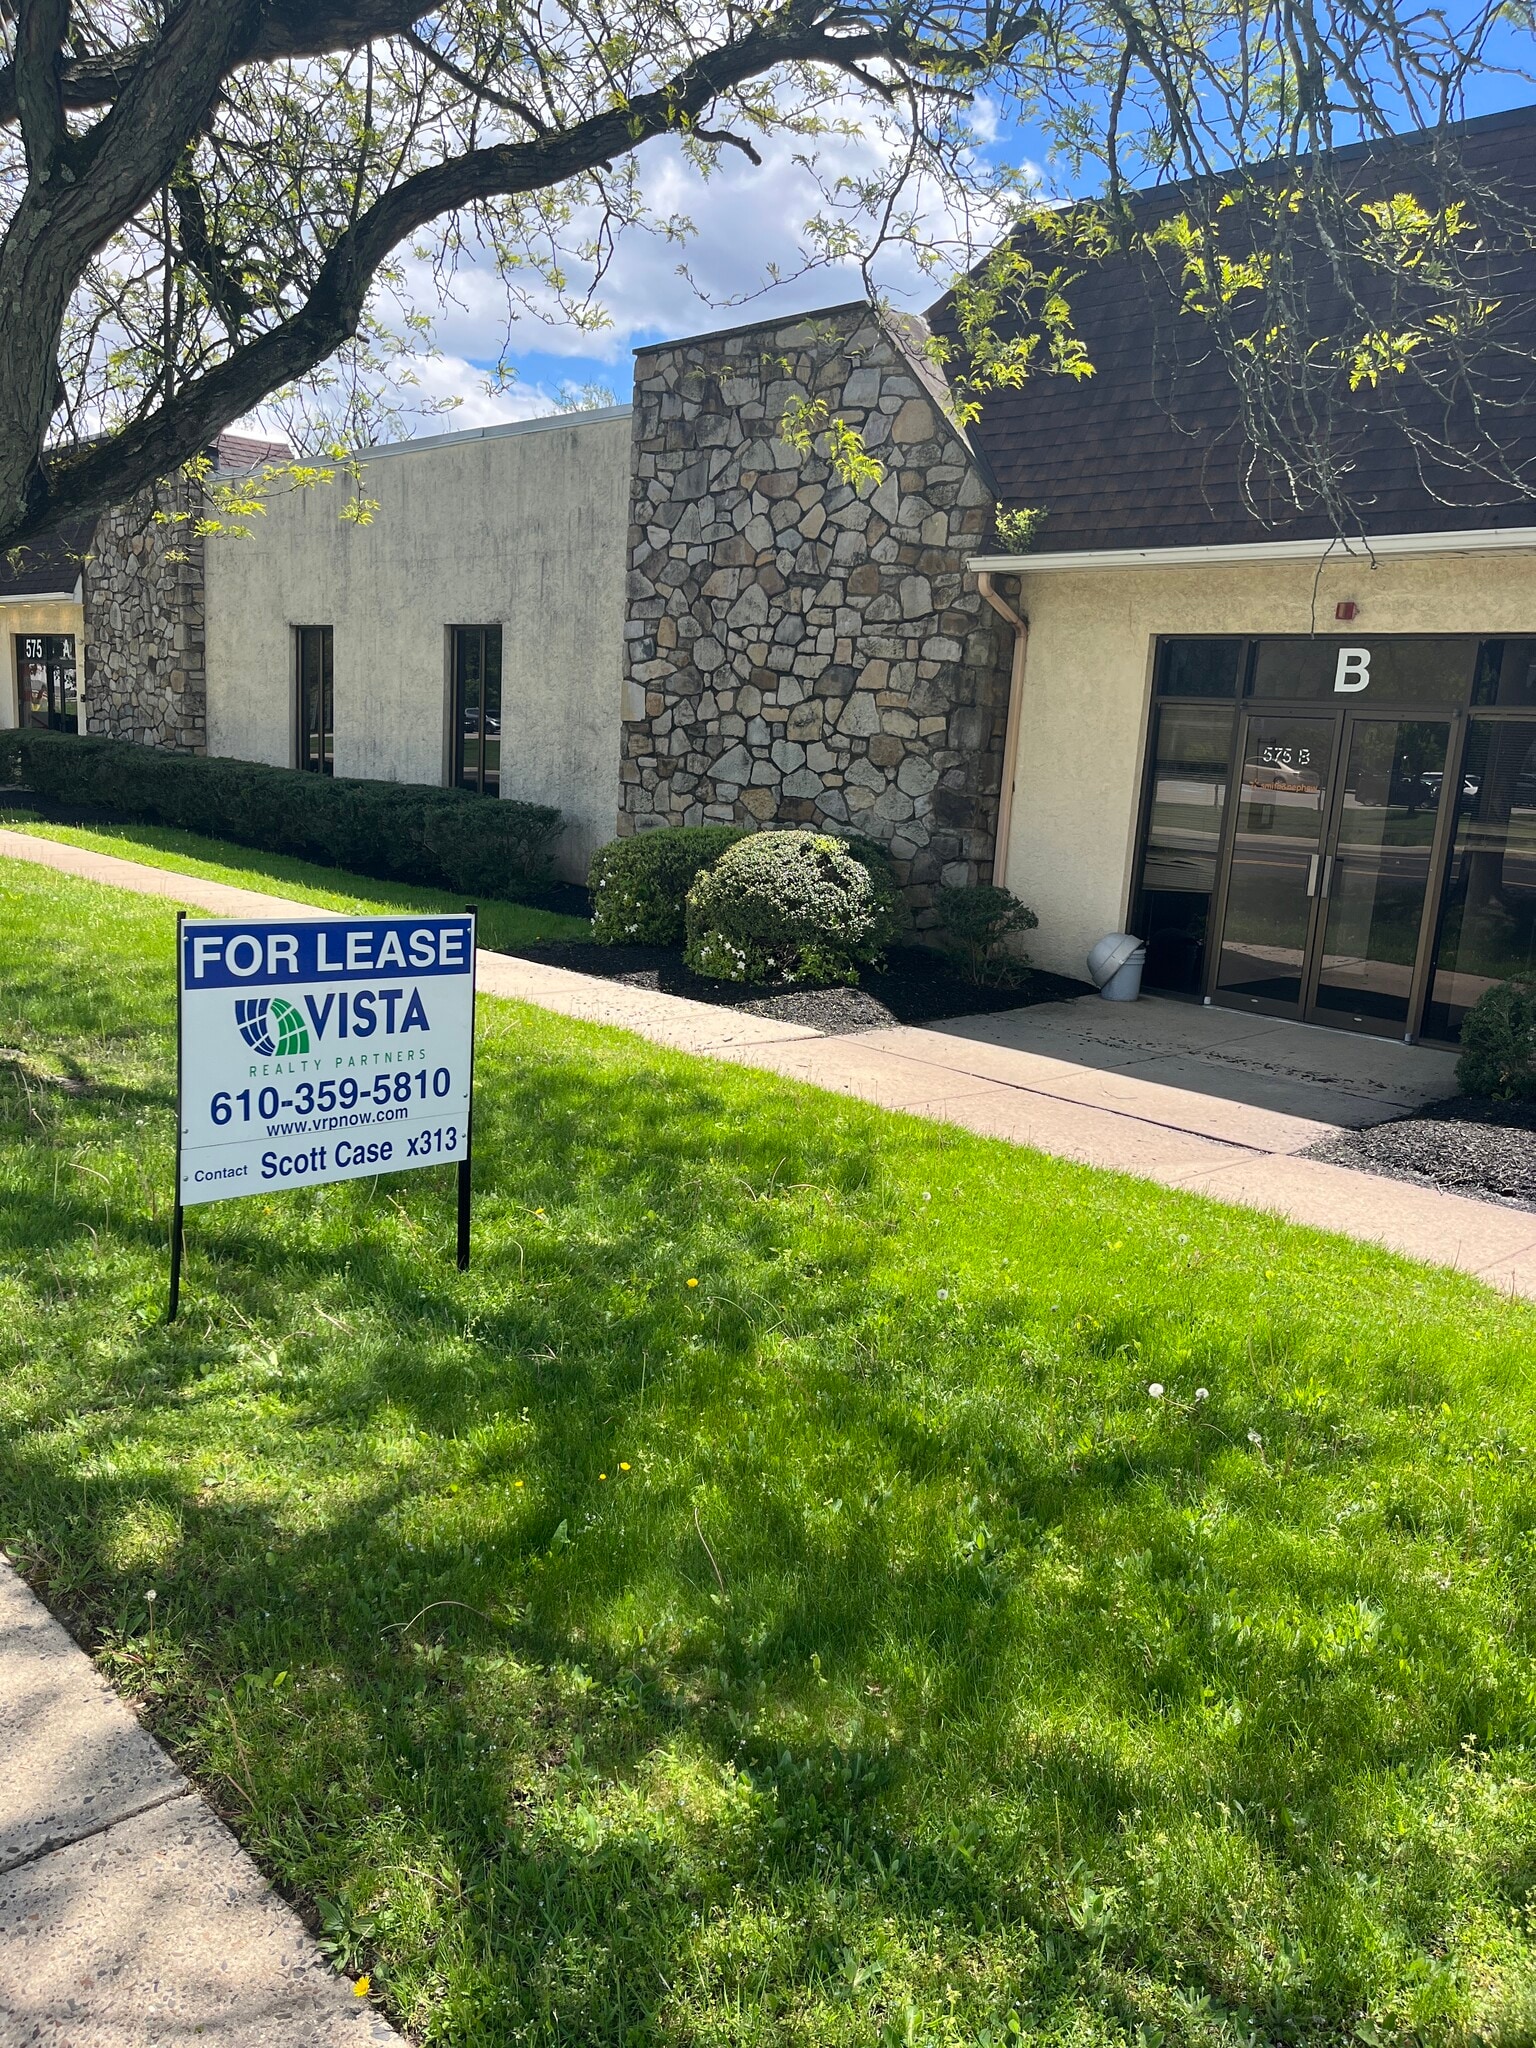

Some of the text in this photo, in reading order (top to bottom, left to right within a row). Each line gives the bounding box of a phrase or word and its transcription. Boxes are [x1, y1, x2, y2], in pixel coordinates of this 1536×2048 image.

[26, 640, 42, 658] 575
[1334, 647, 1371, 693] B
[1263, 746, 1293, 764] 575
[193, 928, 464, 979] FOR LEASE
[303, 986, 430, 1041] VISTA
[249, 1048, 427, 1077] REALTY PARTNERS
[210, 1067, 451, 1126] 610-359-5810
[266, 1106, 409, 1137] www.vrpnow.com
[194, 1126, 458, 1182] Contact Scott Case x313
